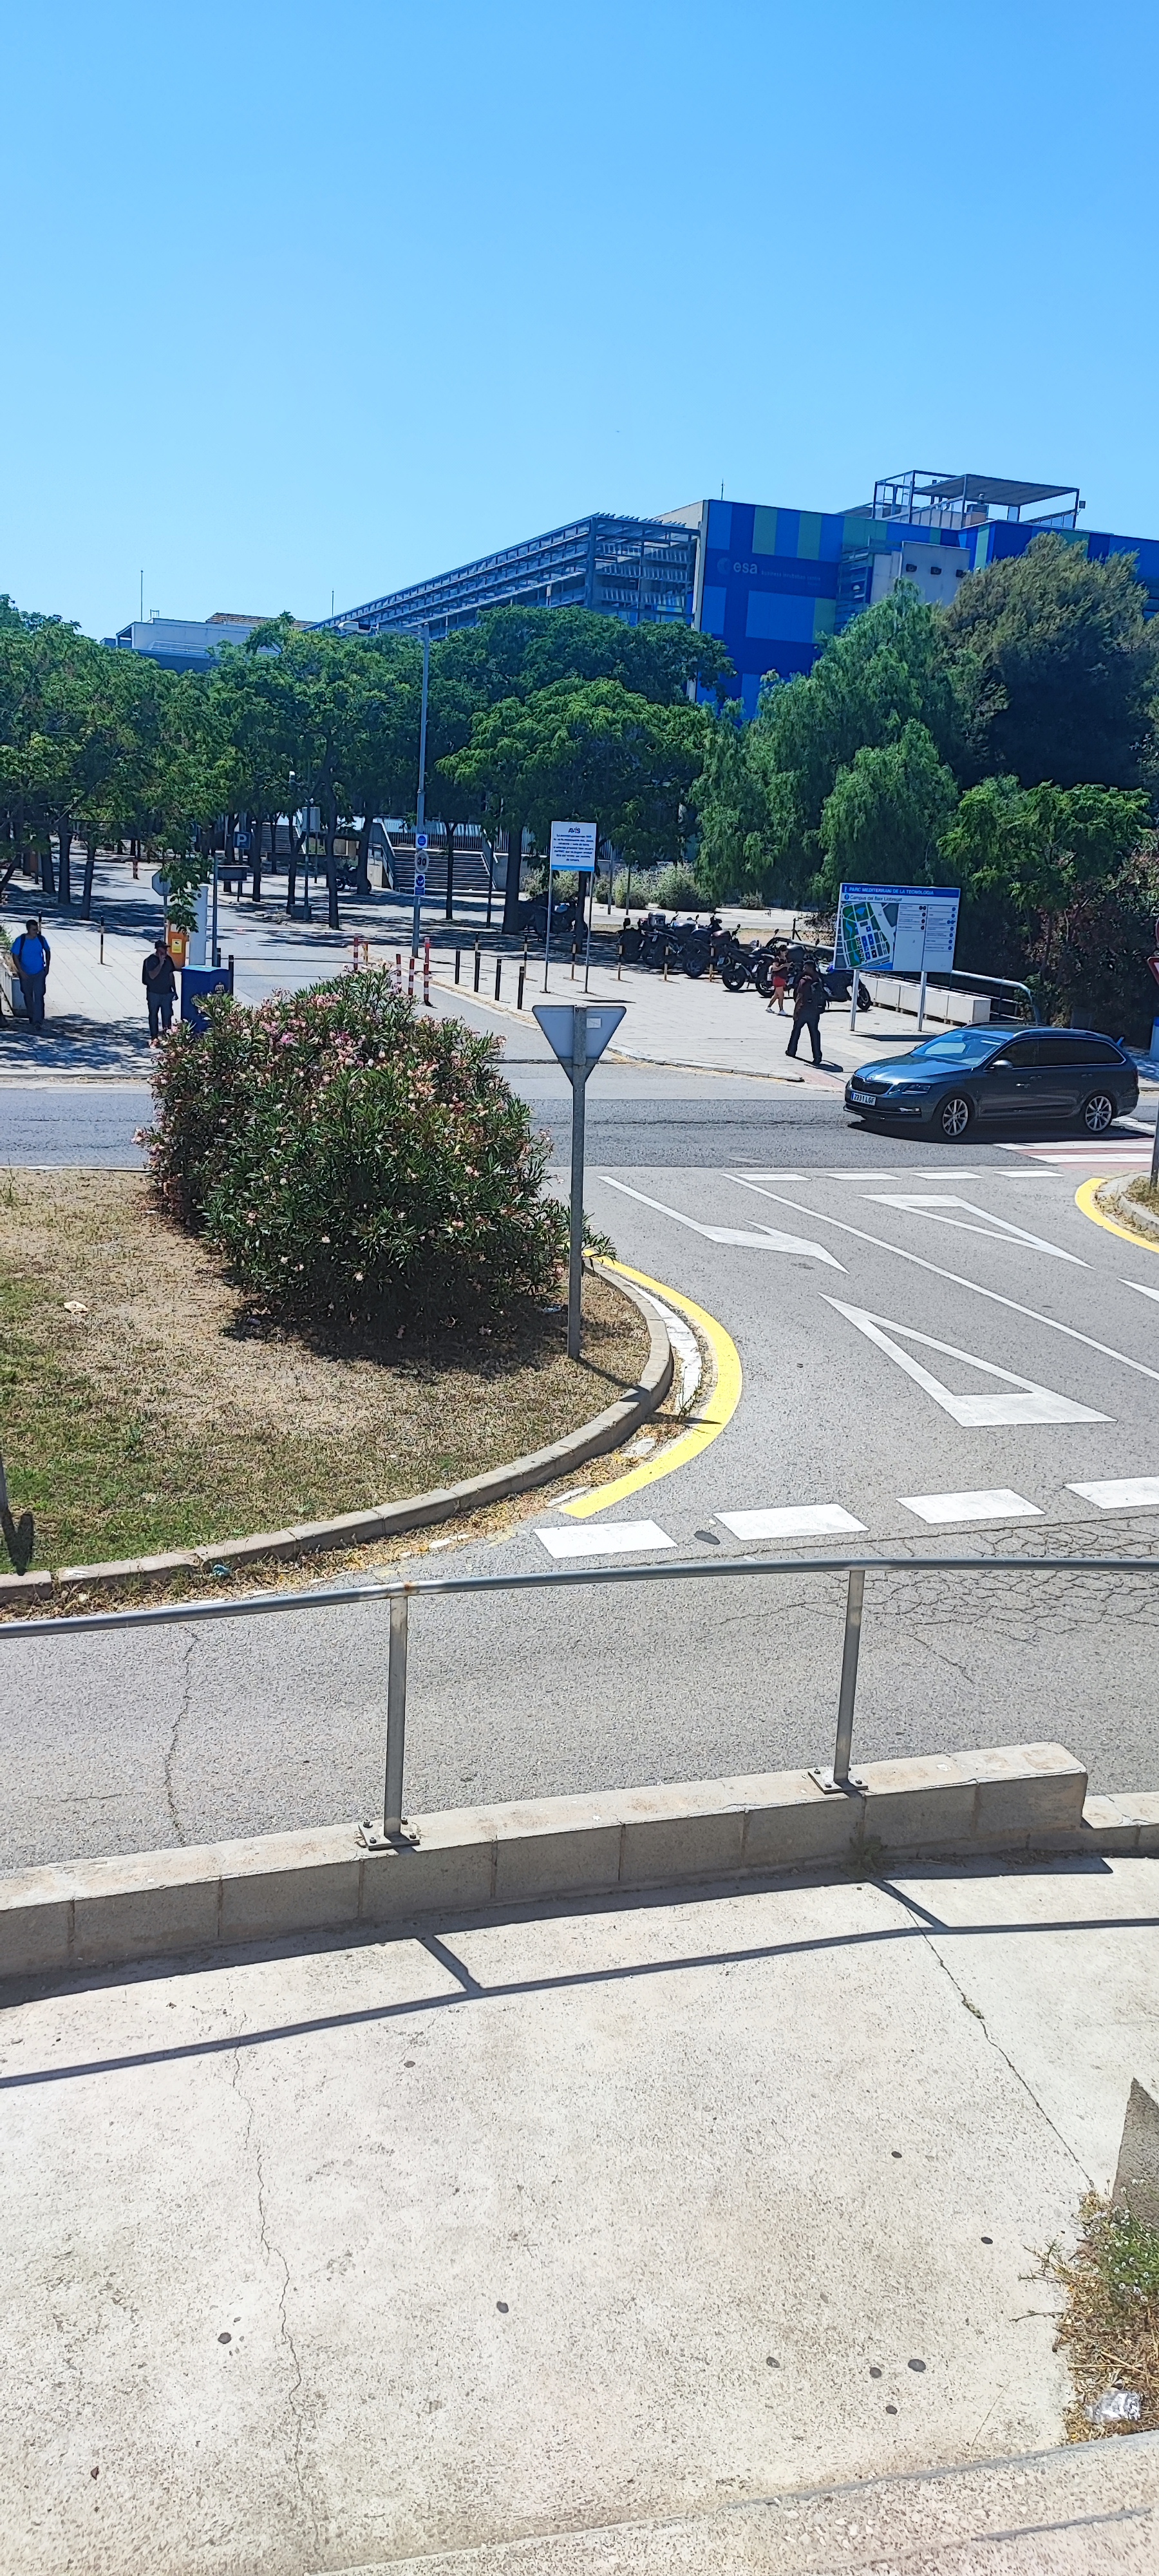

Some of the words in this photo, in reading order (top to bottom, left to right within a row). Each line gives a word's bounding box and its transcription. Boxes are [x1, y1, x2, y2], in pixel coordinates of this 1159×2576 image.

[733, 562, 757, 574] esa
[236, 833, 247, 847] P
[417, 857, 427, 866] 30
